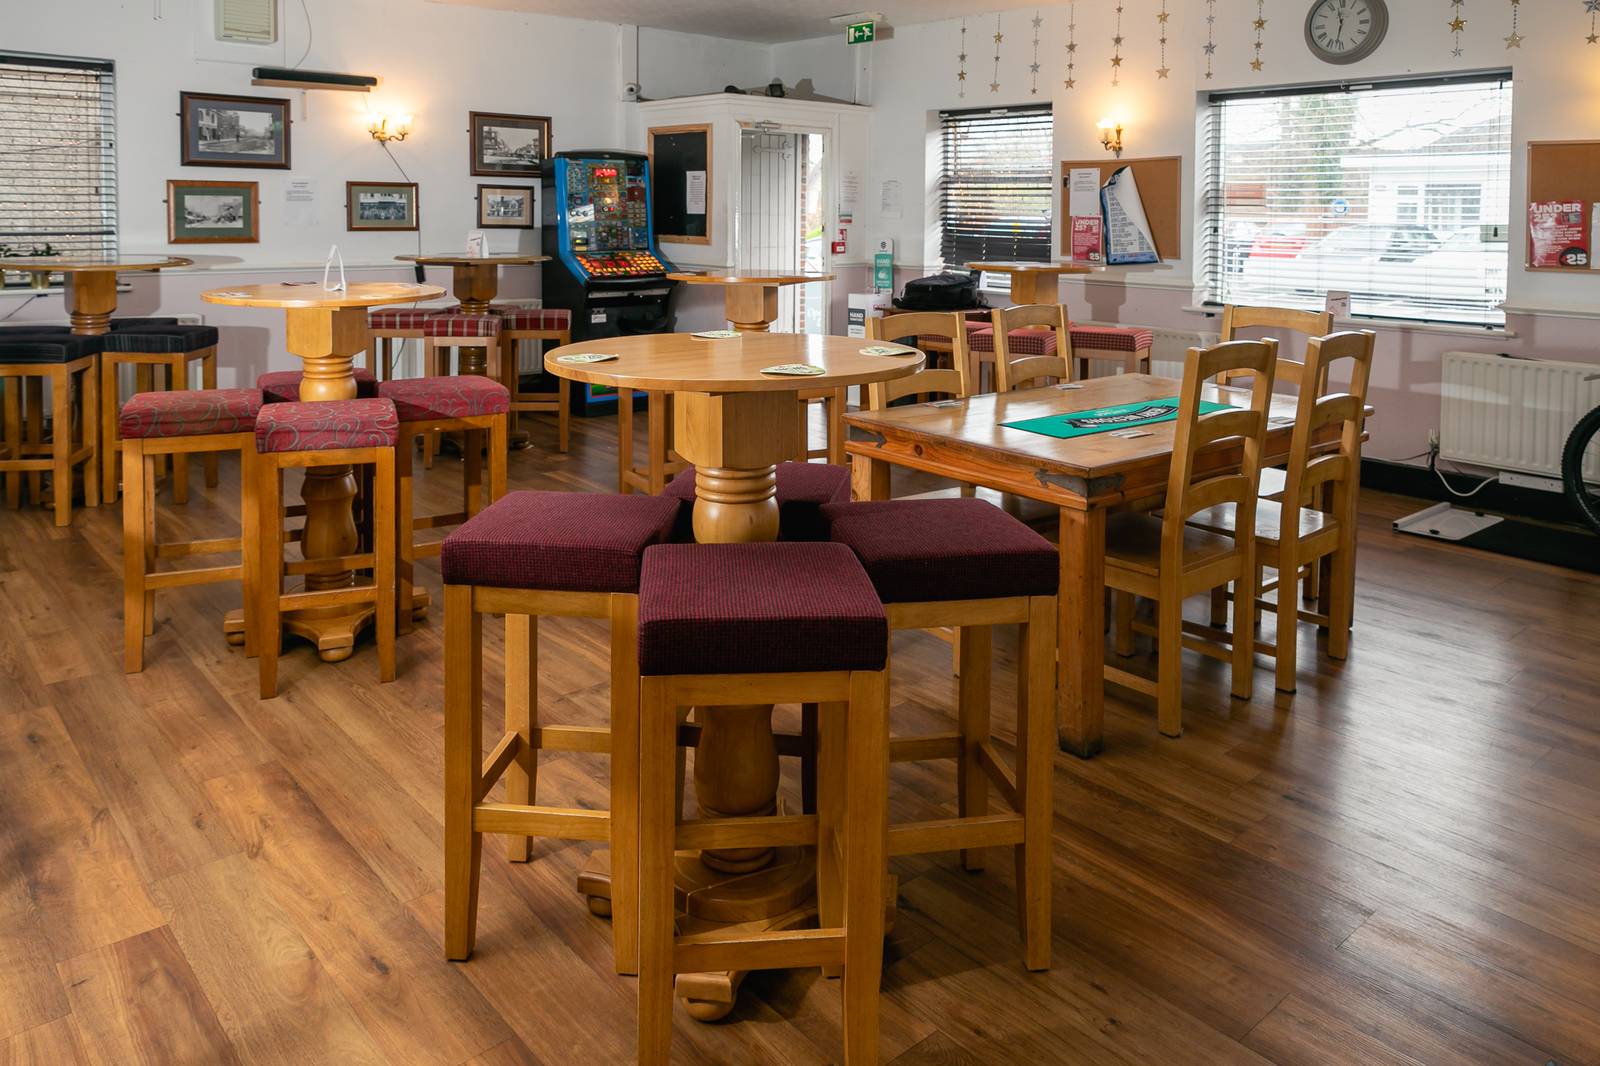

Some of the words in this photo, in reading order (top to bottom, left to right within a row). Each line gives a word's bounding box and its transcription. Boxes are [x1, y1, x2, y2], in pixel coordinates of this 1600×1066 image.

[1533, 203, 1582, 213] UNDER
[1089, 252, 1100, 261] 25
[1566, 253, 1587, 265] 25
